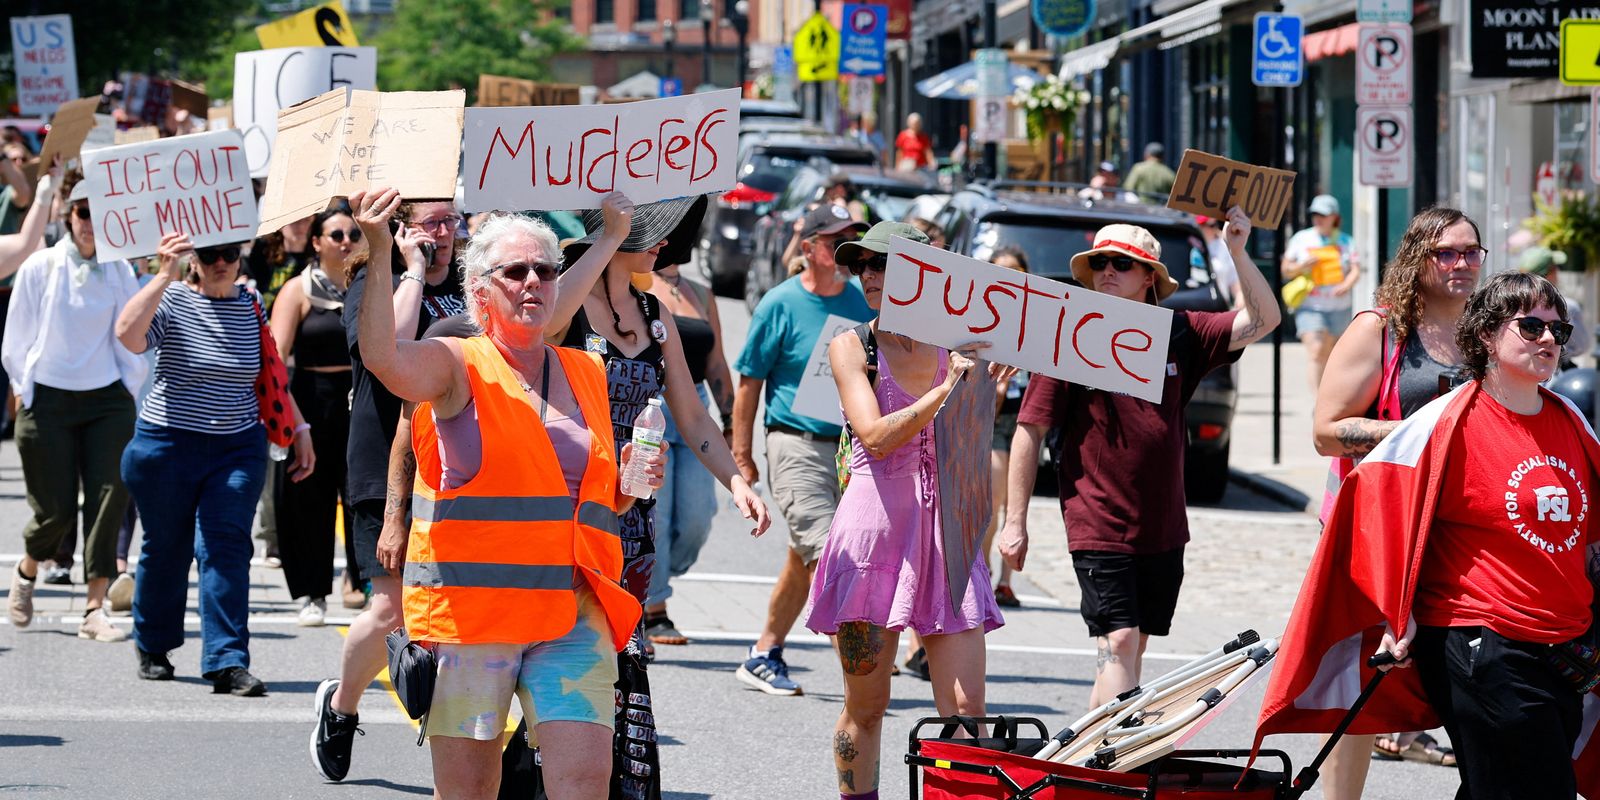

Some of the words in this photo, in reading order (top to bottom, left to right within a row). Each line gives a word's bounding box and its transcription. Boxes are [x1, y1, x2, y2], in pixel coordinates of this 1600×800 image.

[1483, 7, 1546, 27] MOON
[16, 21, 65, 49] US
[1505, 31, 1560, 51] PLAN
[312, 116, 355, 145] WE
[369, 118, 427, 139] ARE
[340, 143, 379, 159] NOT
[99, 152, 165, 197] ICE
[174, 146, 240, 190] OUT
[315, 163, 388, 186] SAFE
[1176, 161, 1250, 213] ICE
[1245, 172, 1294, 225] OUT
[103, 206, 139, 248] OF
[155, 187, 249, 237] MAINE
[610, 360, 653, 383] FREE
[814, 362, 834, 378] IC
[611, 402, 641, 427] ERTY
[1507, 455, 1567, 489] SOCIALISM
[1505, 491, 1520, 521] FOR
[1537, 495, 1572, 522] PSL
[1513, 522, 1555, 554] PARTY
